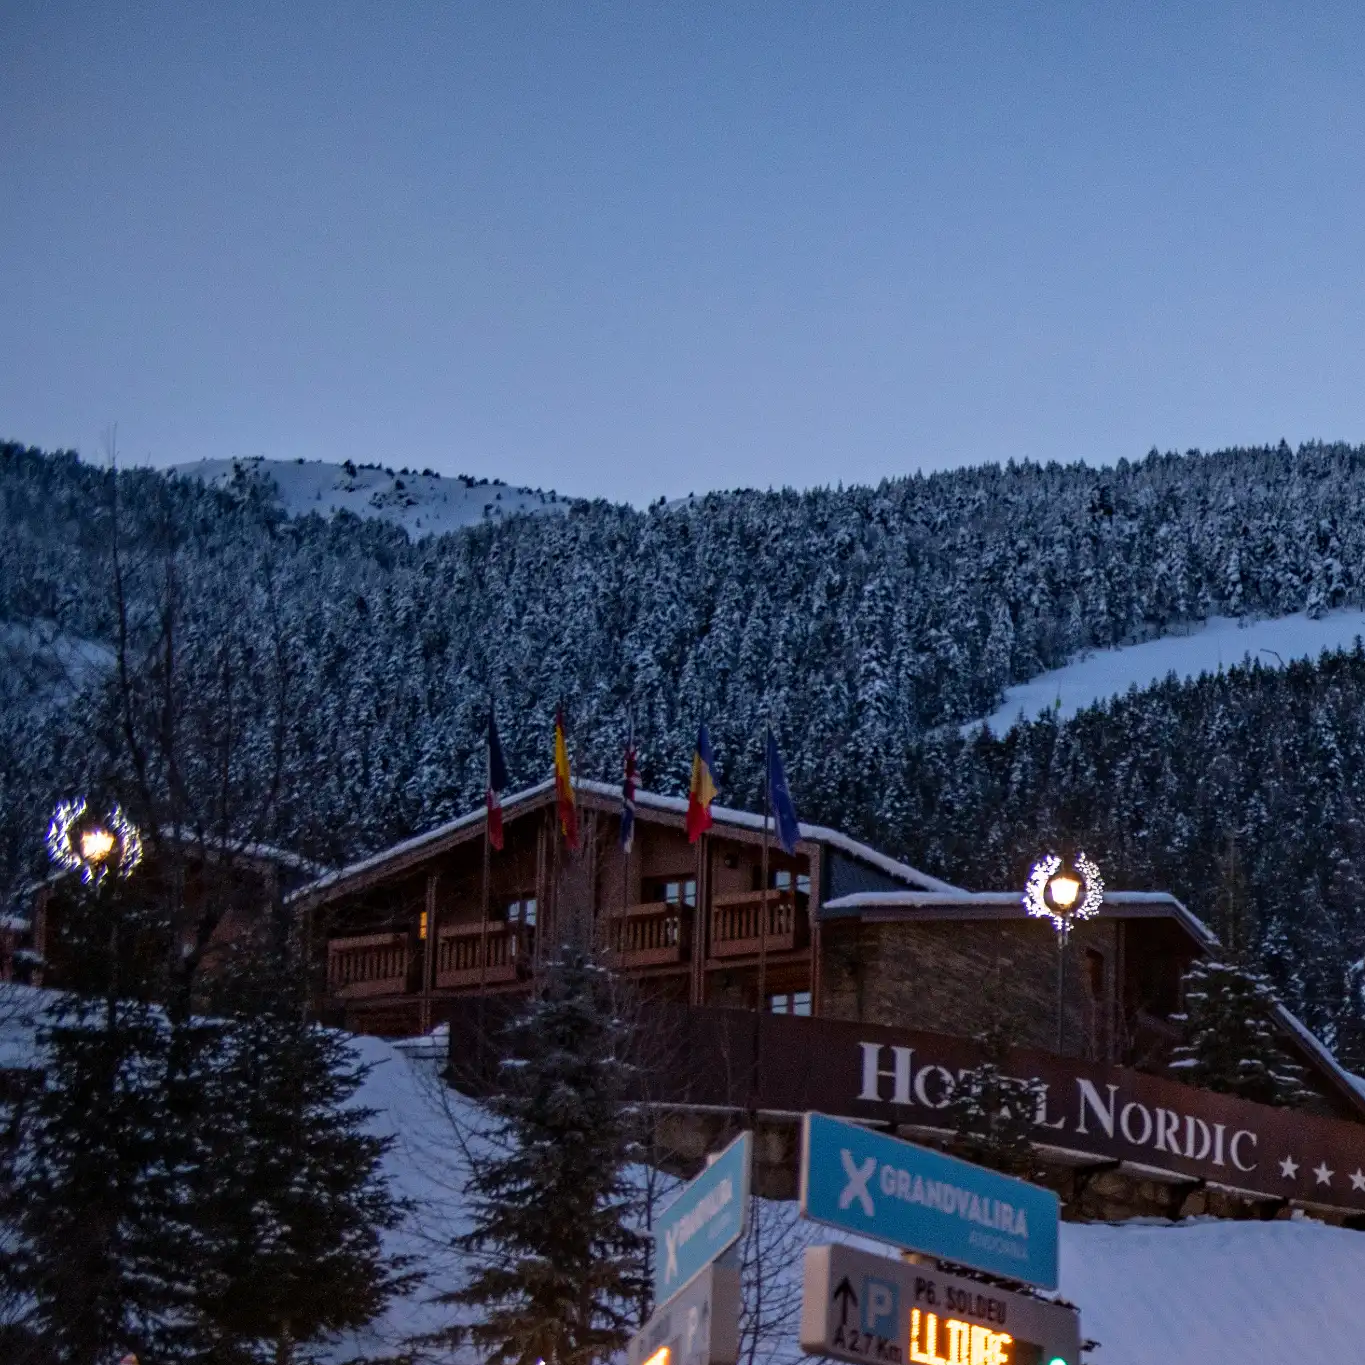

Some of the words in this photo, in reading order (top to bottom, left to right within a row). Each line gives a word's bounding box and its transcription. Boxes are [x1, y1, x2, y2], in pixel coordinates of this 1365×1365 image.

[1075, 1077, 1259, 1173] NORDIC
[879, 1163, 1029, 1240] GRANDVALIRA
[945, 1286, 1007, 1325] SOLDEU
